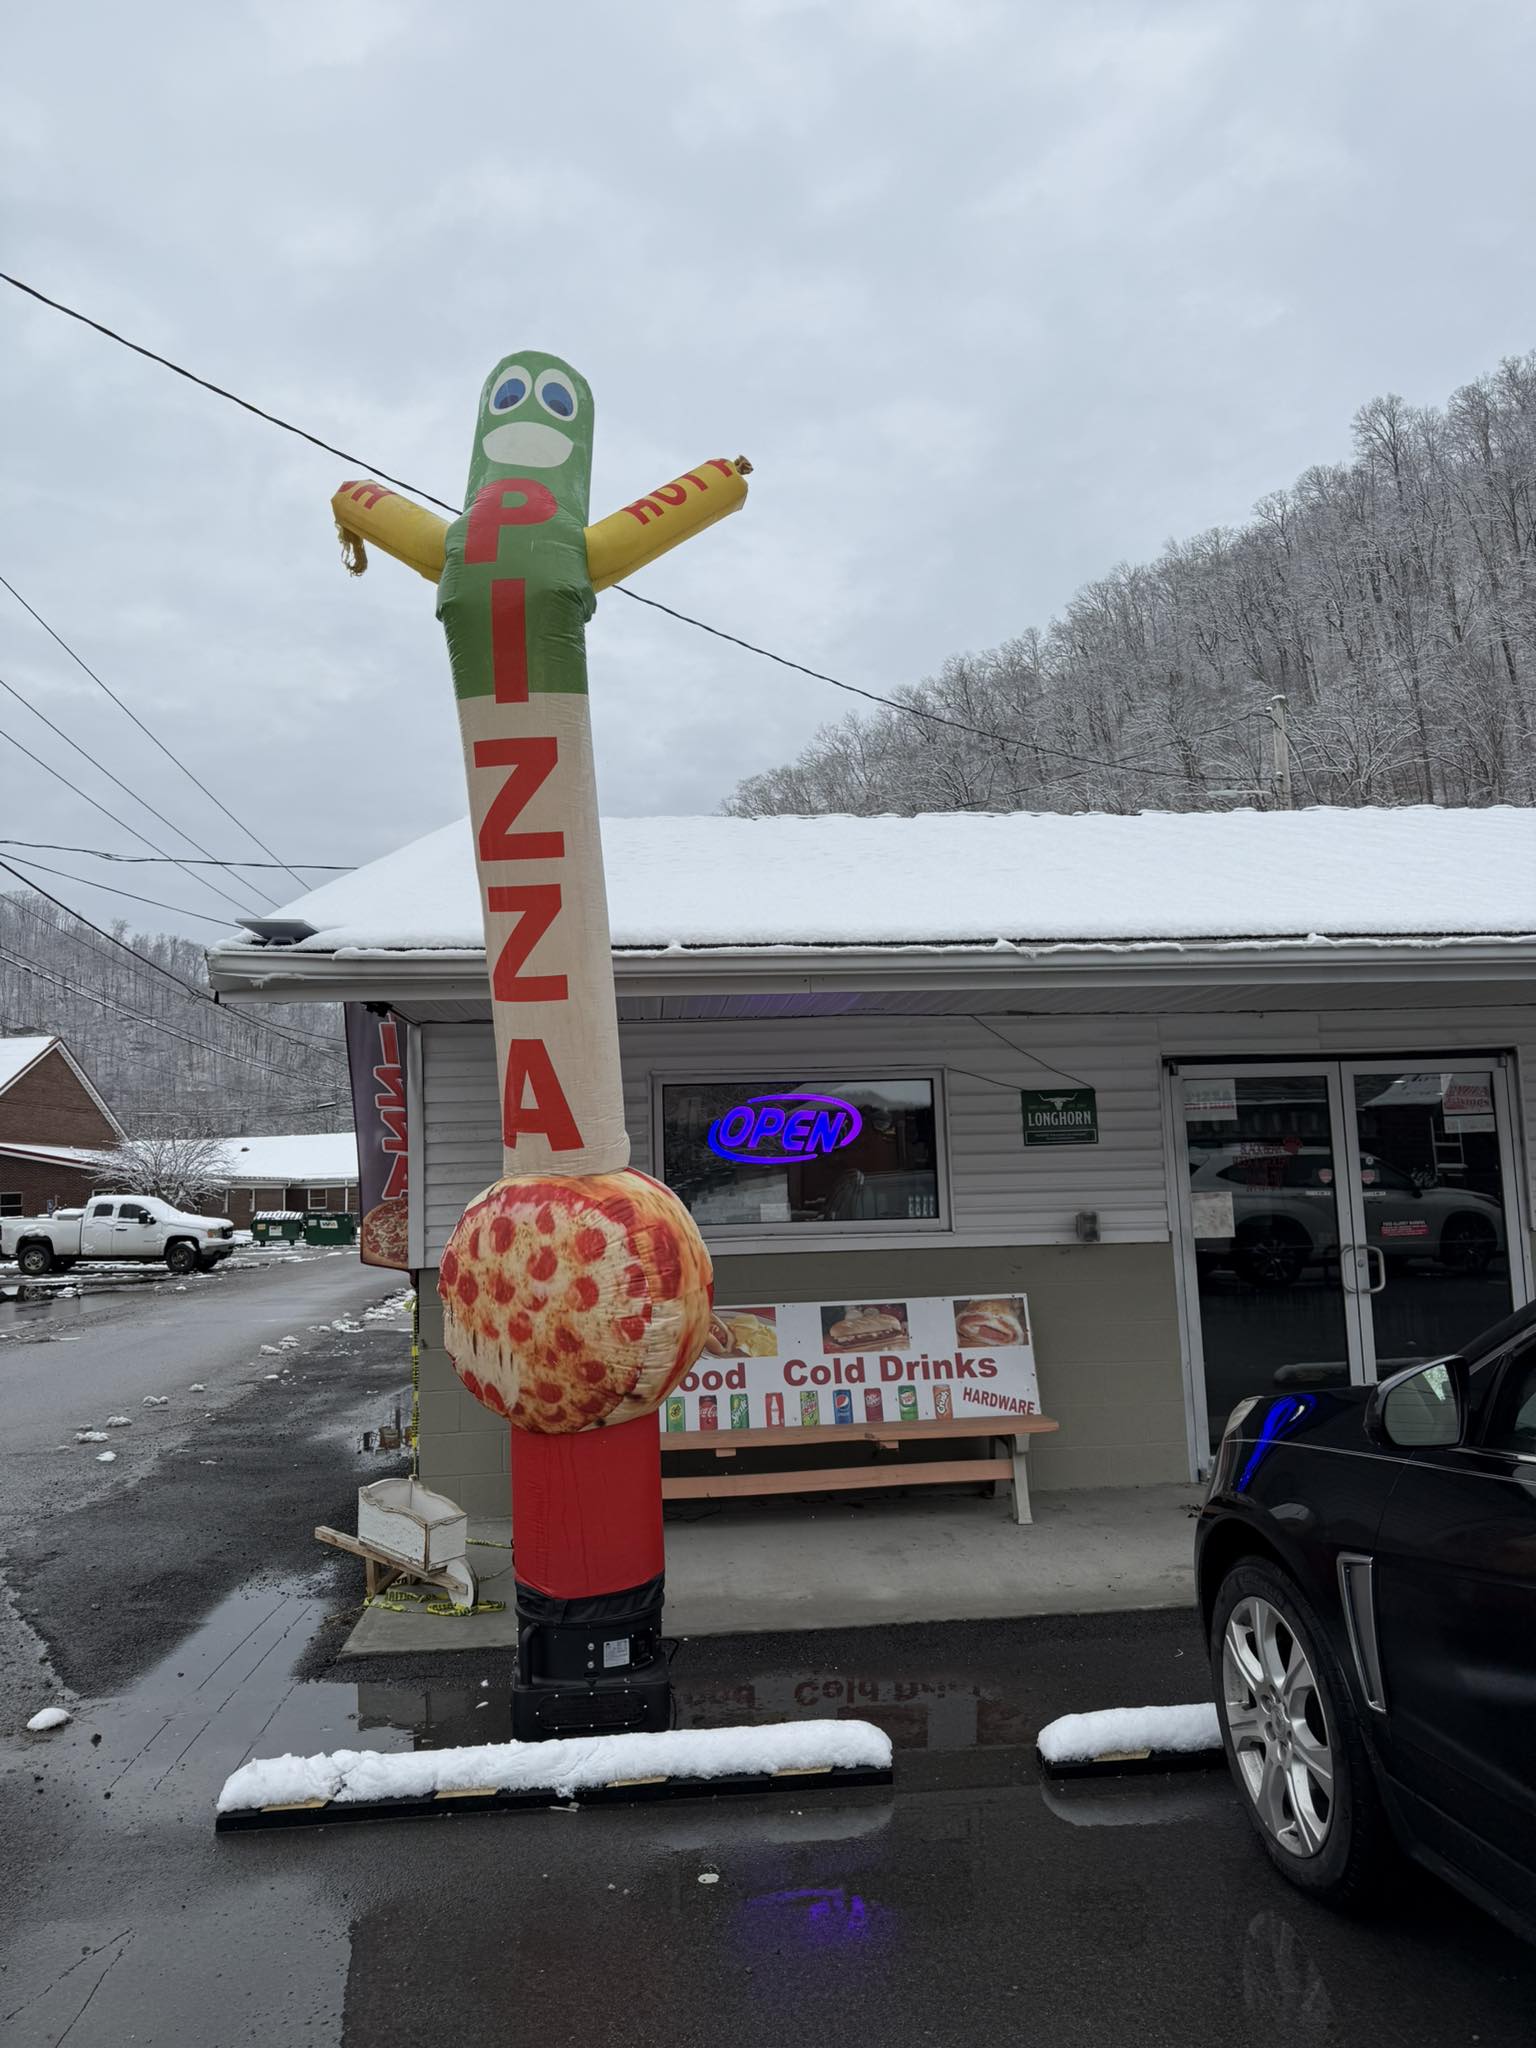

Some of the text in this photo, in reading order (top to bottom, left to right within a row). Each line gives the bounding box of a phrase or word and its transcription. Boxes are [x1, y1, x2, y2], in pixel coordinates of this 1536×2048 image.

[463, 478, 585, 1152] PIZZA
[719, 1106, 846, 1153] OPEN
[1027, 1110, 1092, 1127] LONGHORN
[679, 1352, 999, 1393] ood Cold Drinks
[963, 1387, 1036, 1416] HARDWARE
